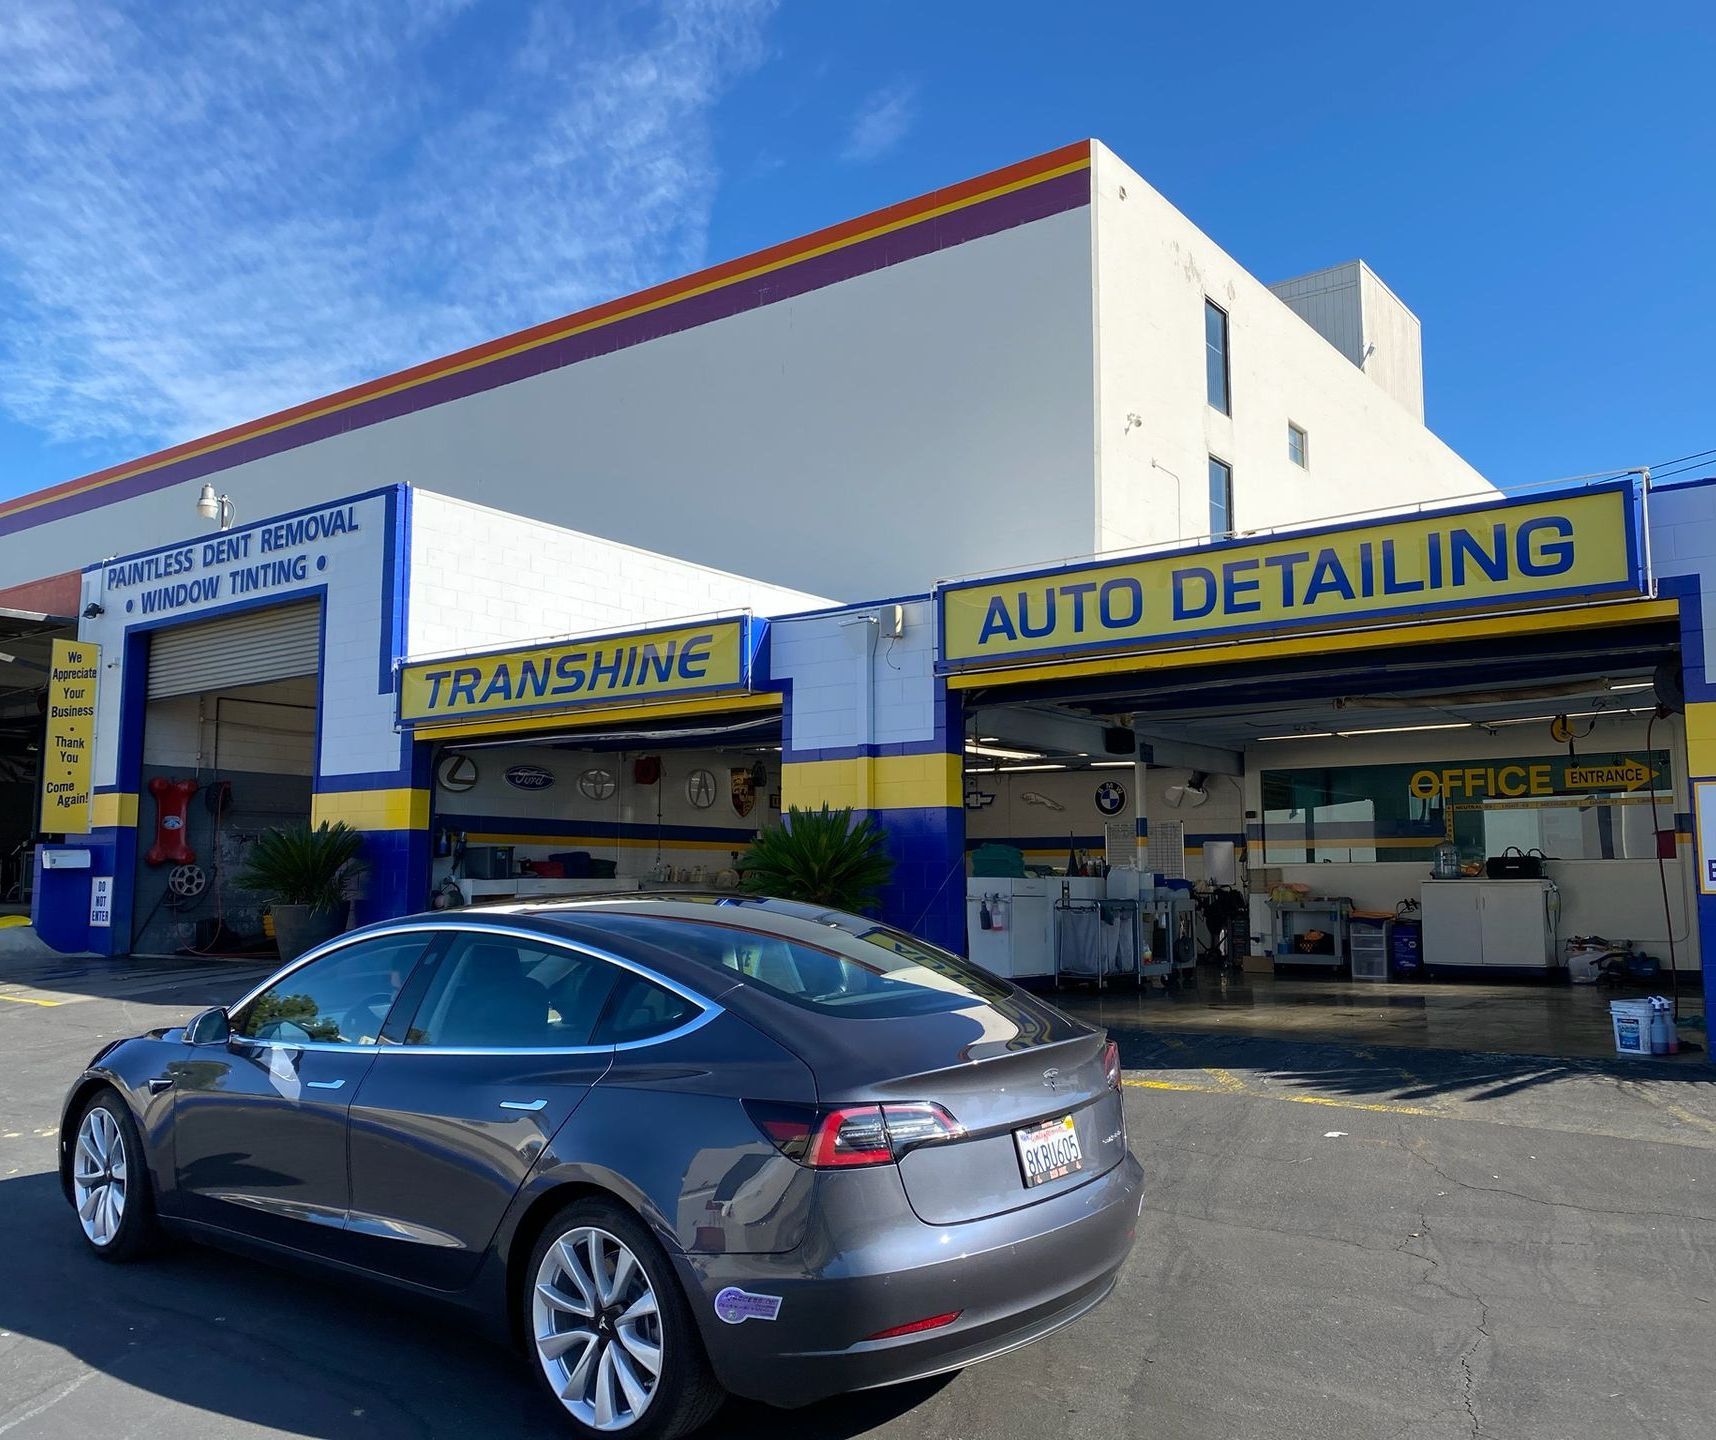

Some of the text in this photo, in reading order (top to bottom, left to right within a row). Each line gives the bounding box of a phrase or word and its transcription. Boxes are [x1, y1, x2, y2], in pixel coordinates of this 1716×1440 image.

[108, 507, 359, 590] PAINTLESS DENT REMOVAL
[141, 555, 307, 614] WINDOW TINTING
[977, 516, 1576, 646] AUTO DETAILING
[68, 652, 82, 663] We
[53, 667, 97, 682] Appreciate
[424, 634, 714, 709] TRANSHINE
[64, 688, 85, 699] Your
[51, 706, 94, 718] Business
[55, 736, 85, 749] Thank
[60, 751, 79, 763] You
[509, 767, 549, 787] Ford
[1410, 765, 1643, 798] OFFICE ENTRANCE
[47, 782, 75, 793] Come
[57, 792, 89, 808] Again!
[98, 881, 106, 892] DO
[96, 895, 107, 907] NOT
[92, 910, 109, 921] ENTER
[1026, 1135, 1079, 1175] 8KBU605
